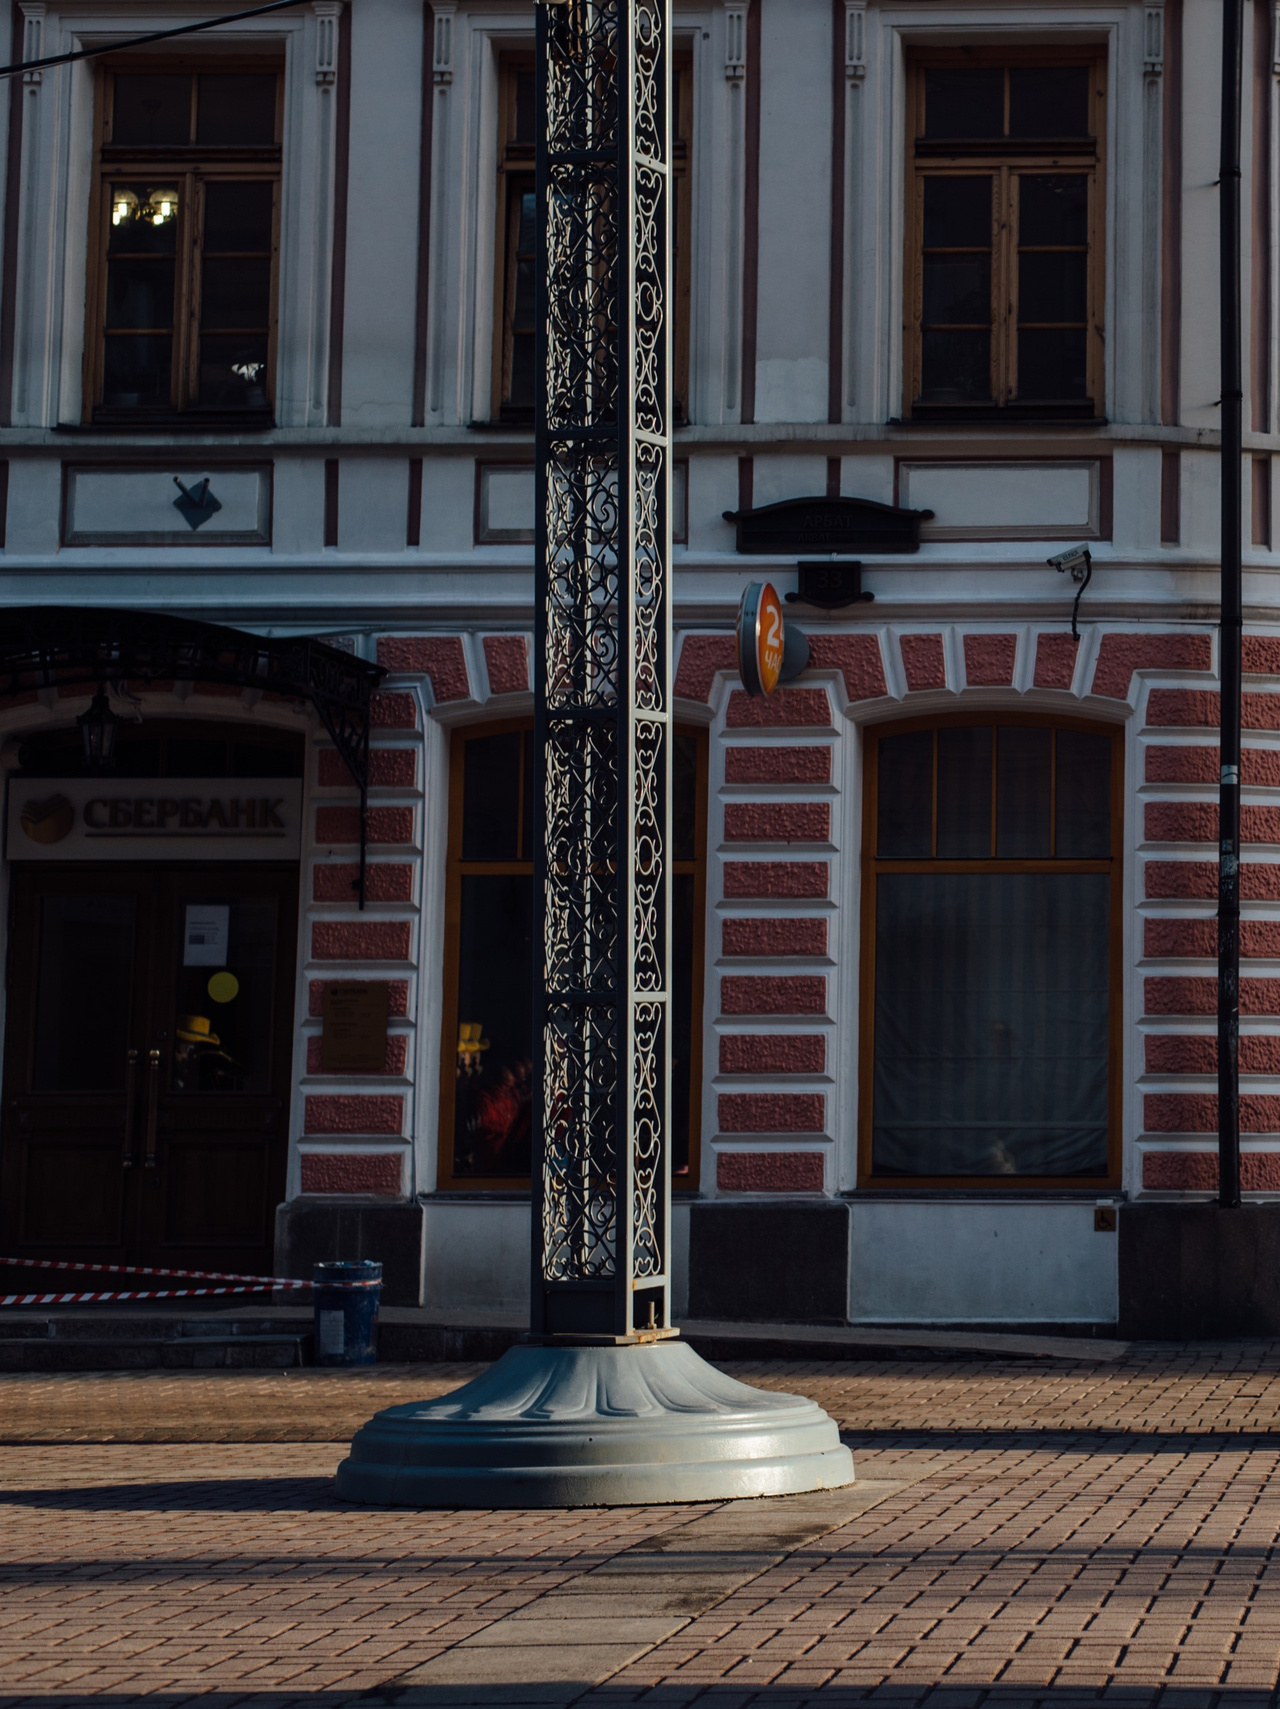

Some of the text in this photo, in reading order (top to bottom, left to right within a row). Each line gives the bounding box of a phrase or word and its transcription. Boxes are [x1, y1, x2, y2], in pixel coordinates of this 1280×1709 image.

[801, 514, 853, 528] АРБАТ
[817, 570, 842, 588] 33
[765, 650, 783, 673] ЧАС
[83, 798, 286, 829] СБЕРБАНК
